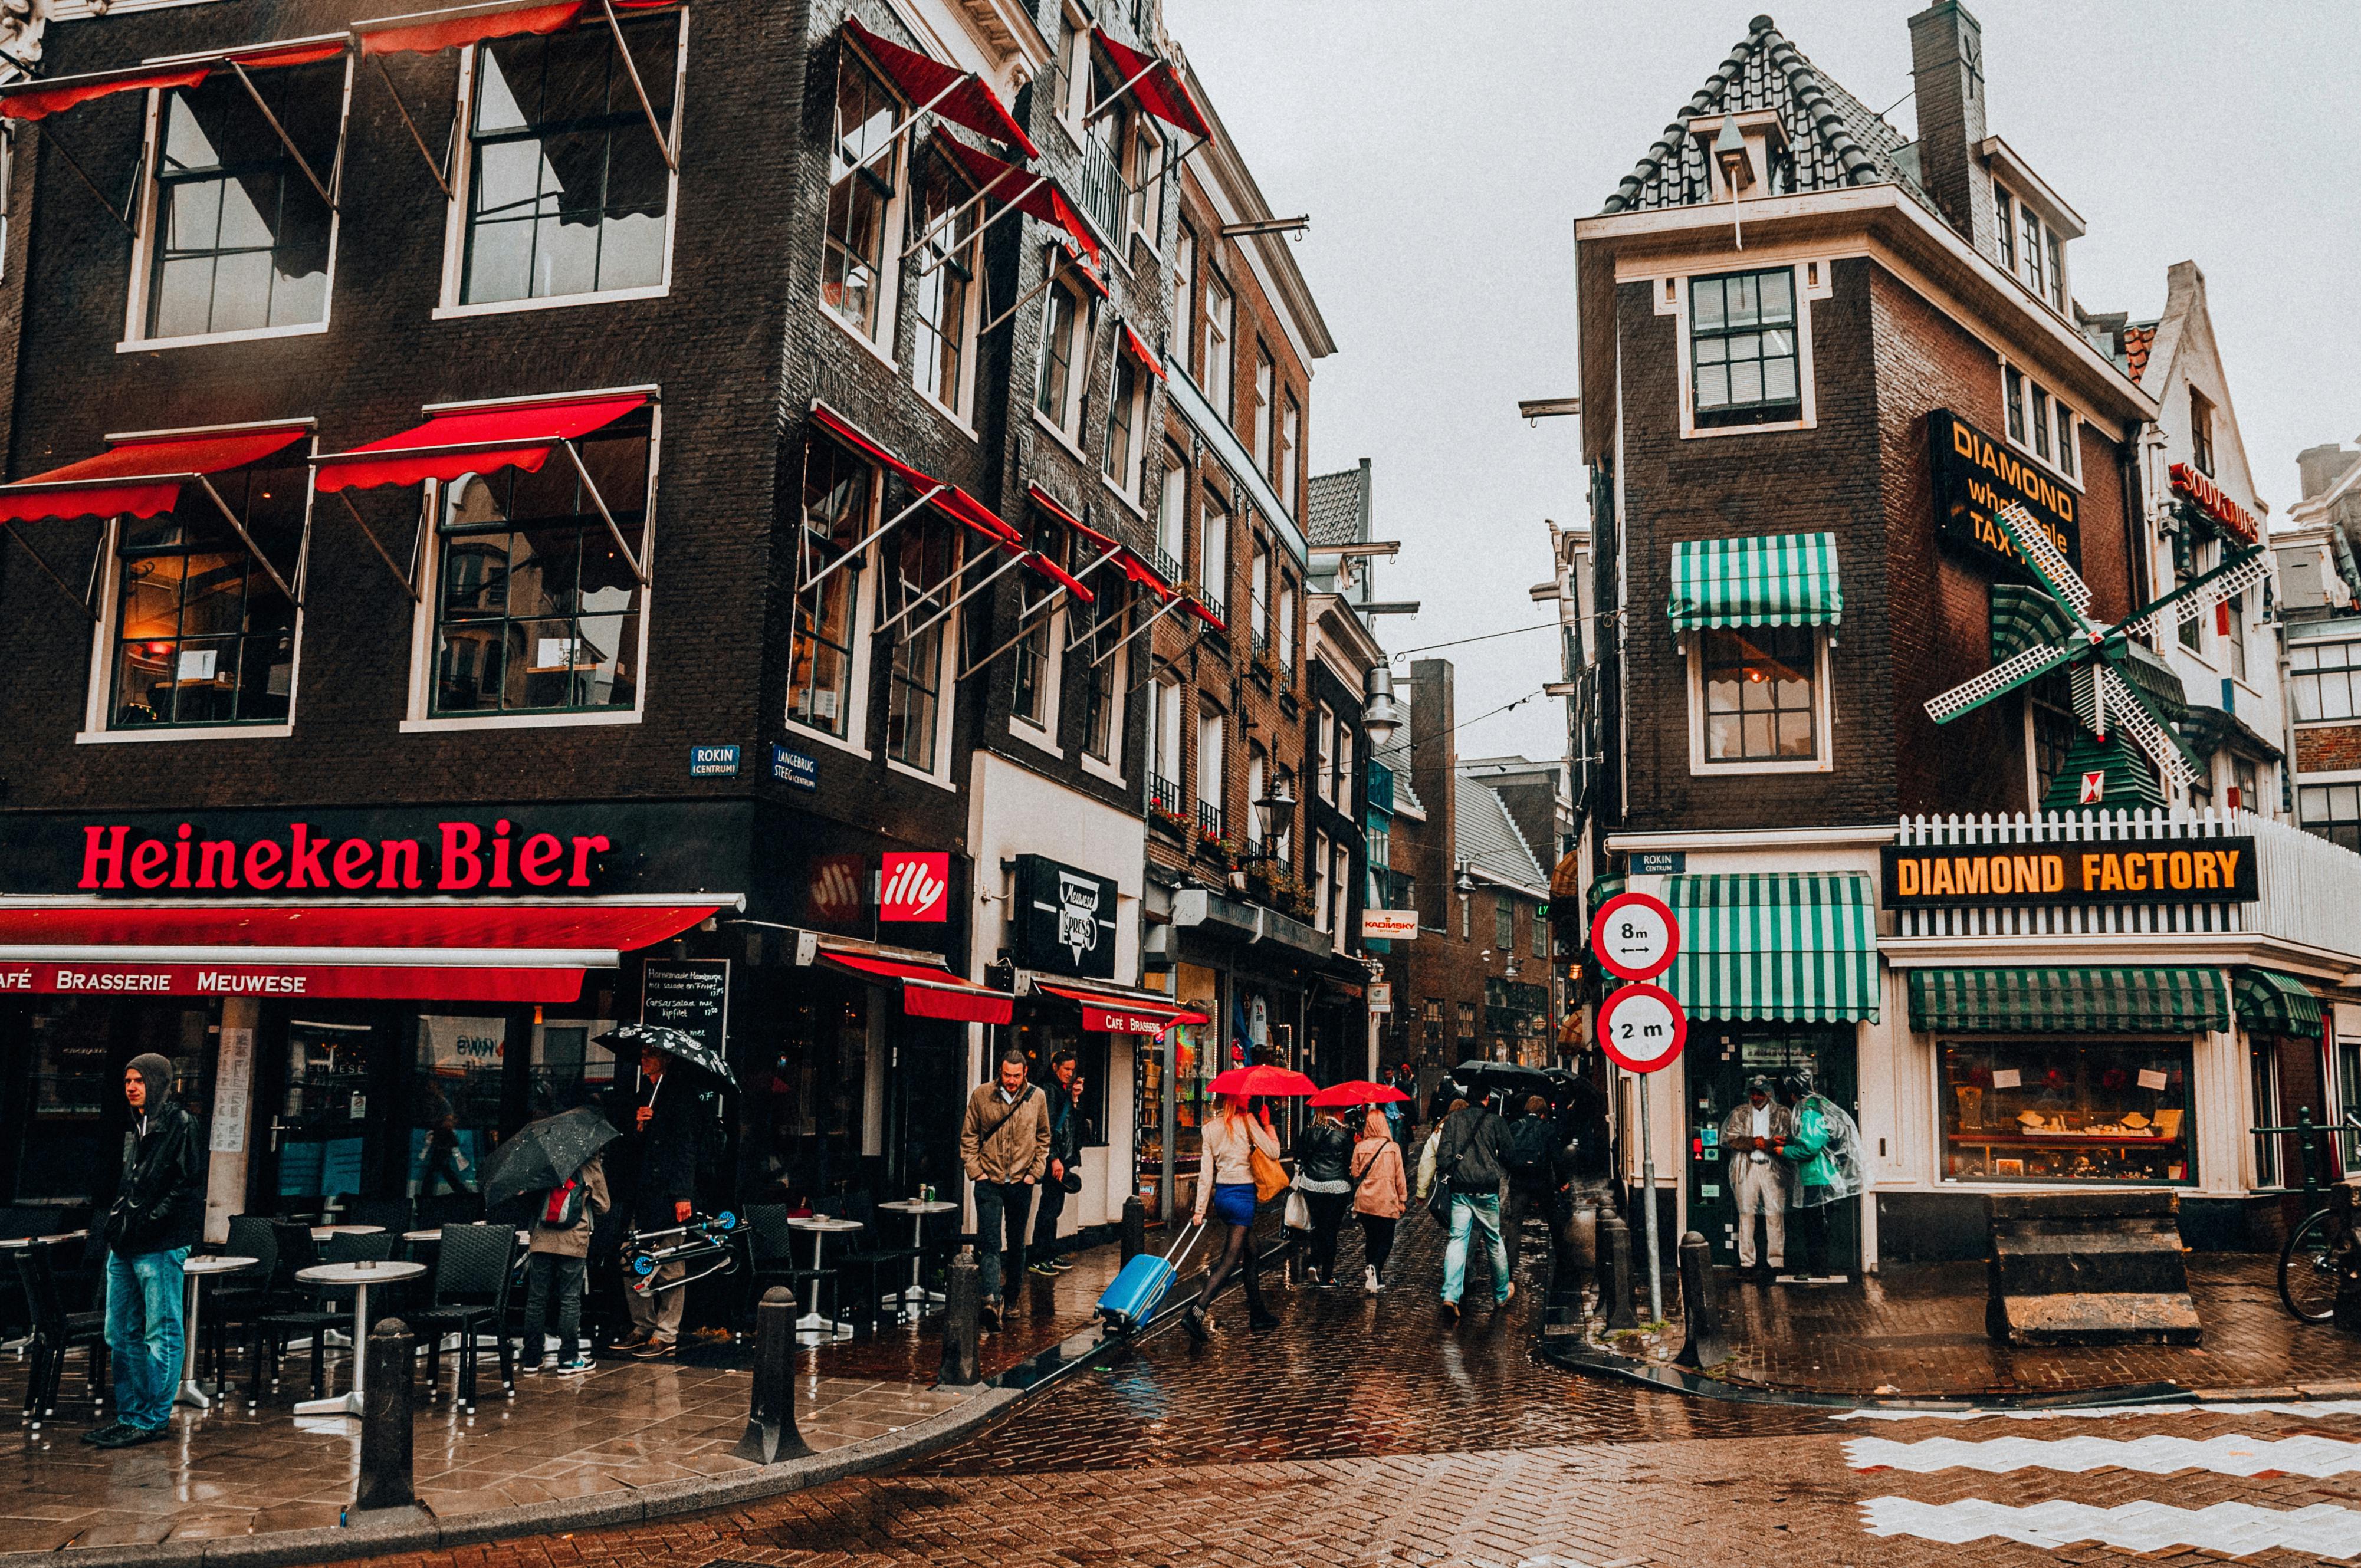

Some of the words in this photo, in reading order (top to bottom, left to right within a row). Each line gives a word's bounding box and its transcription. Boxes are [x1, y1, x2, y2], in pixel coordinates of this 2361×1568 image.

[1953, 421, 2073, 522] DIAMOND
[698, 749, 733, 761] ROKIN
[777, 750, 814, 773] LANGEBRUG
[693, 765, 735, 774] (CENTRUM)
[774, 765, 792, 781] STEEG
[78, 823, 422, 890] Heineken
[438, 818, 610, 890] Bier
[1643, 854, 1672, 864] ROKIN
[1897, 855, 2064, 896] DIAMOND
[2082, 850, 2240, 892] FACTORY
[884, 861, 945, 916] illy
[1065, 884, 1094, 909] Meuwese
[1365, 921, 1415, 930] KADINSKY
[56, 970, 172, 991] BRASSERIE
[196, 972, 307, 994] MEUWESE
